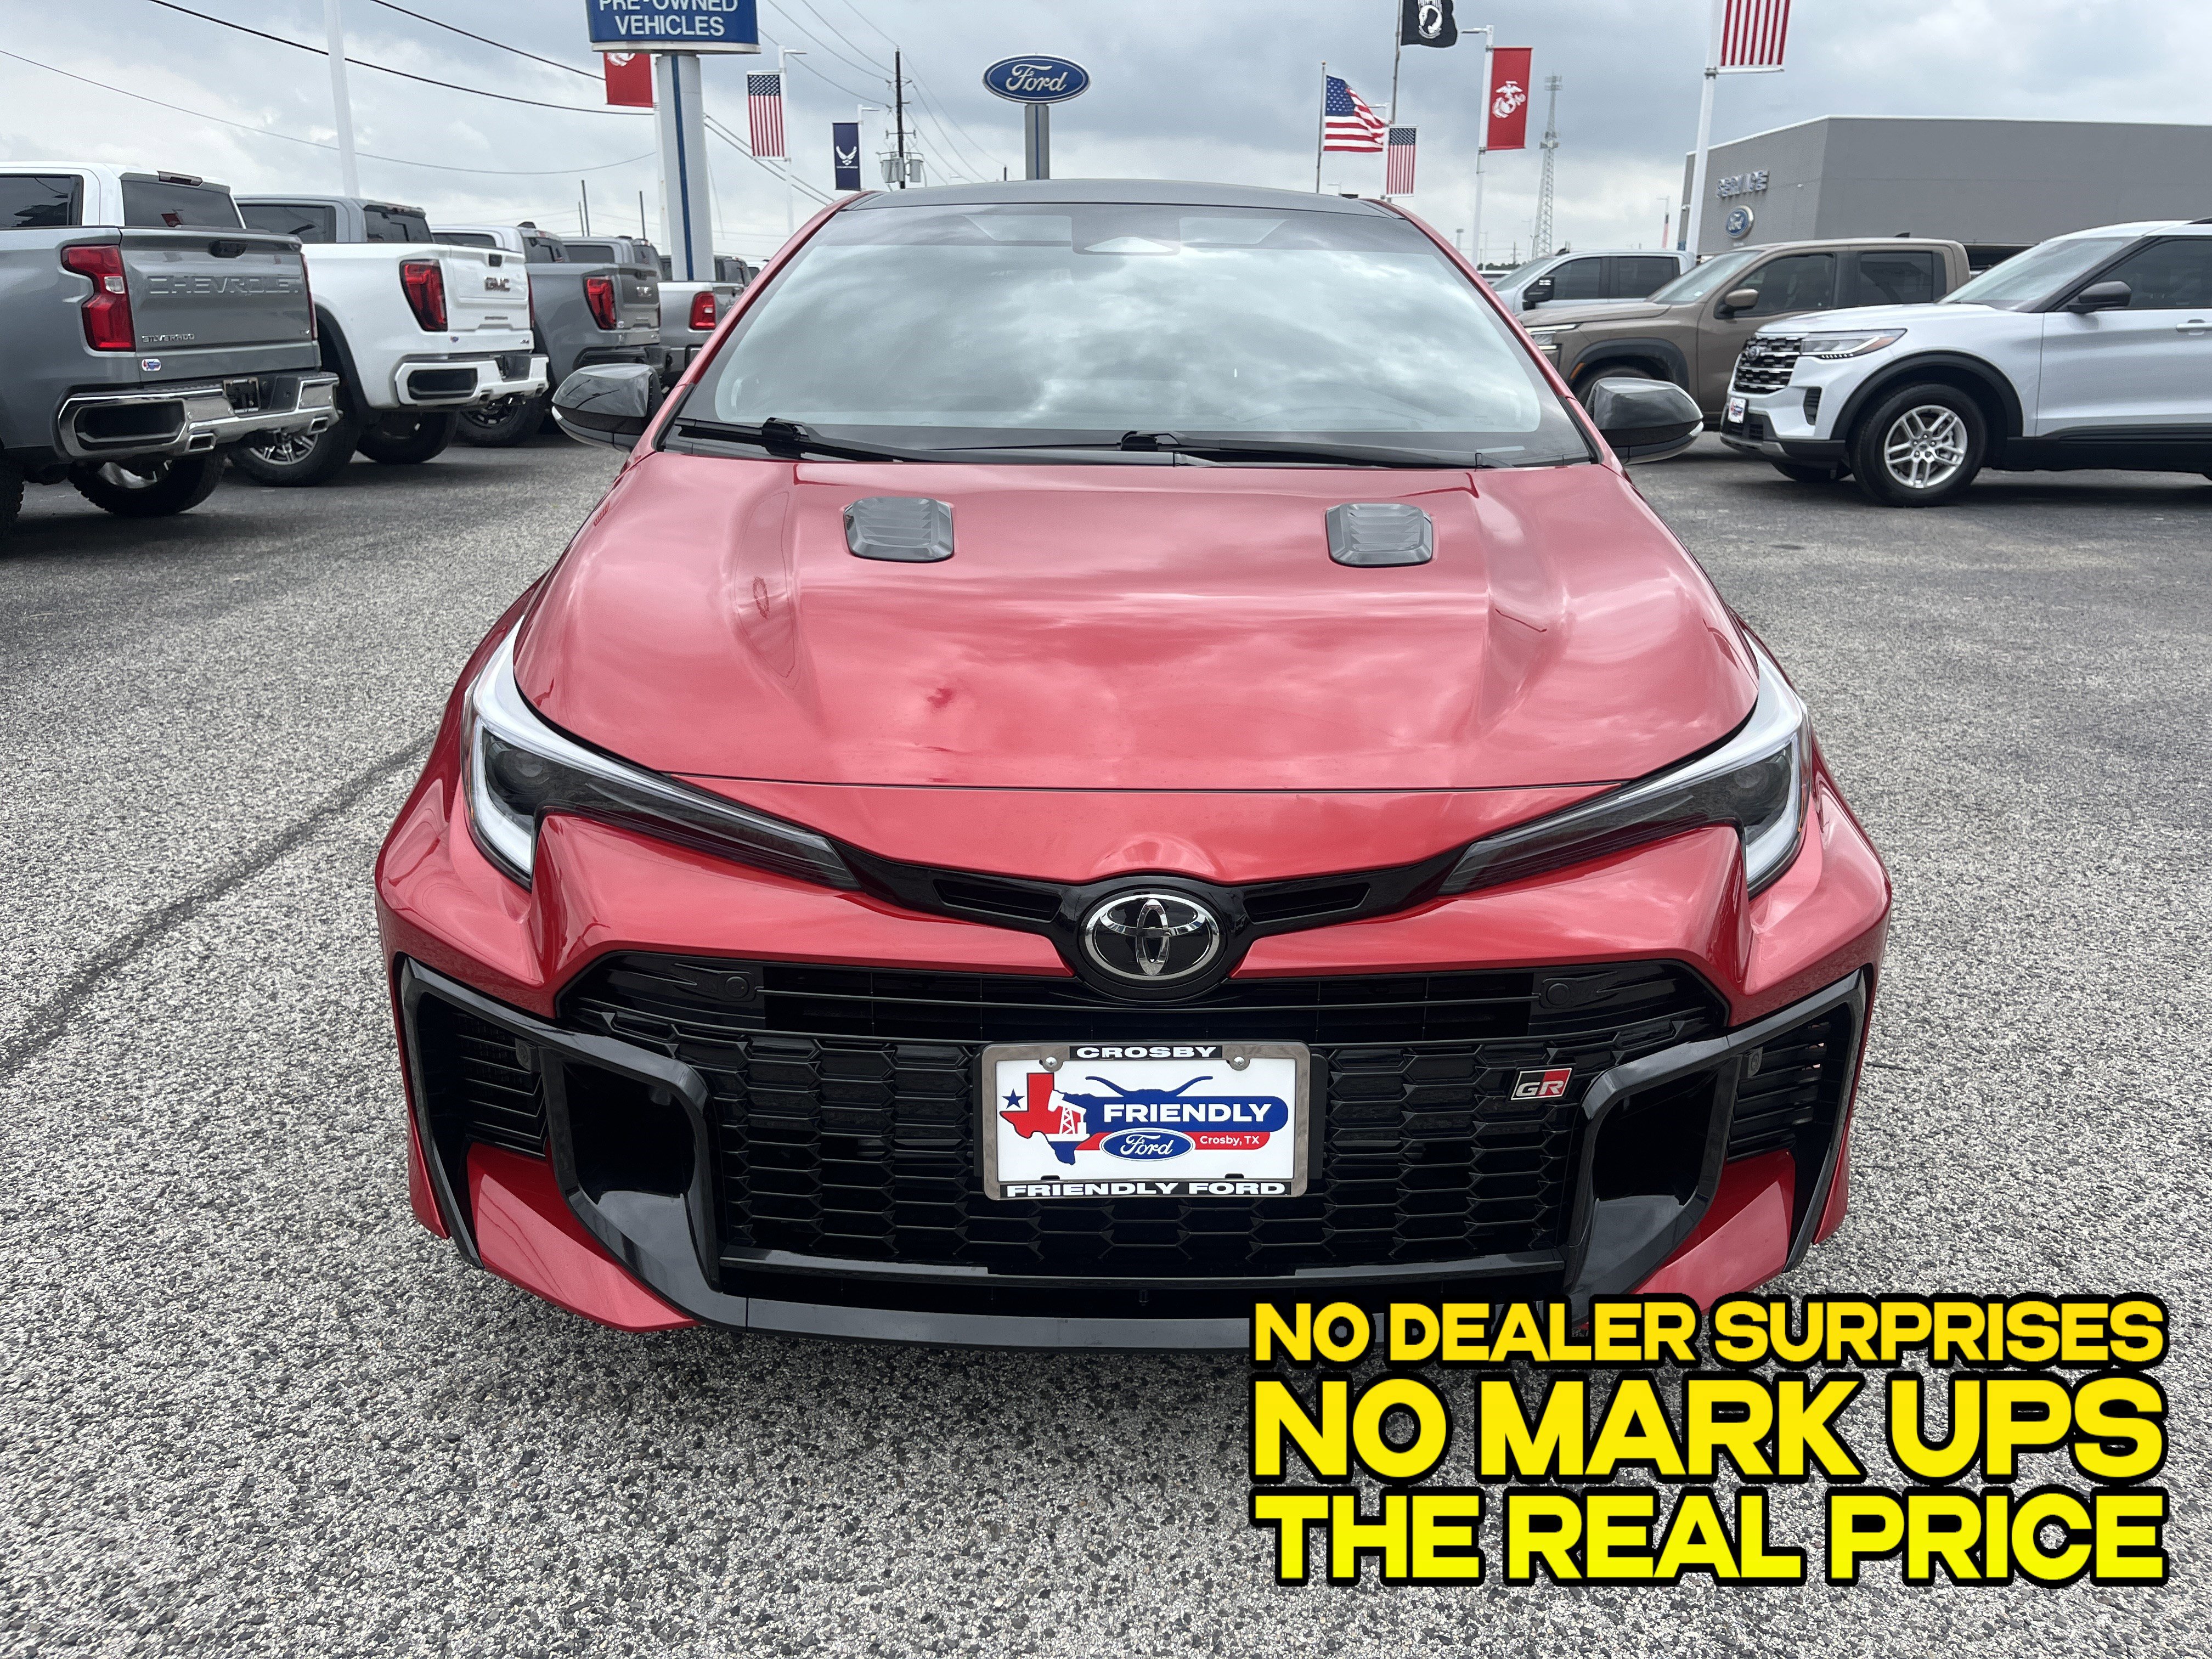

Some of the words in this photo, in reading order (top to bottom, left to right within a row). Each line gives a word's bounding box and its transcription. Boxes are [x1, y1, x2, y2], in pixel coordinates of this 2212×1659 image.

[614, 15, 725, 36] VEHICLES
[1005, 64, 1069, 92] Ford
[1716, 170, 1770, 198] SERVICE
[484, 276, 511, 292] GMC
[141, 333, 195, 343] SILVERADO
[1076, 1047, 1216, 1058] CROSBY
[1516, 1080, 1564, 1097] GR
[1104, 1103, 1272, 1122] FRIENDLY
[1119, 1134, 1173, 1156] Ford
[1199, 1135, 1243, 1147] Crosby,
[1244, 1136, 1260, 1144] TX
[1007, 1182, 1178, 1197] FRIENDLY
[1189, 1182, 1286, 1195] FORD
